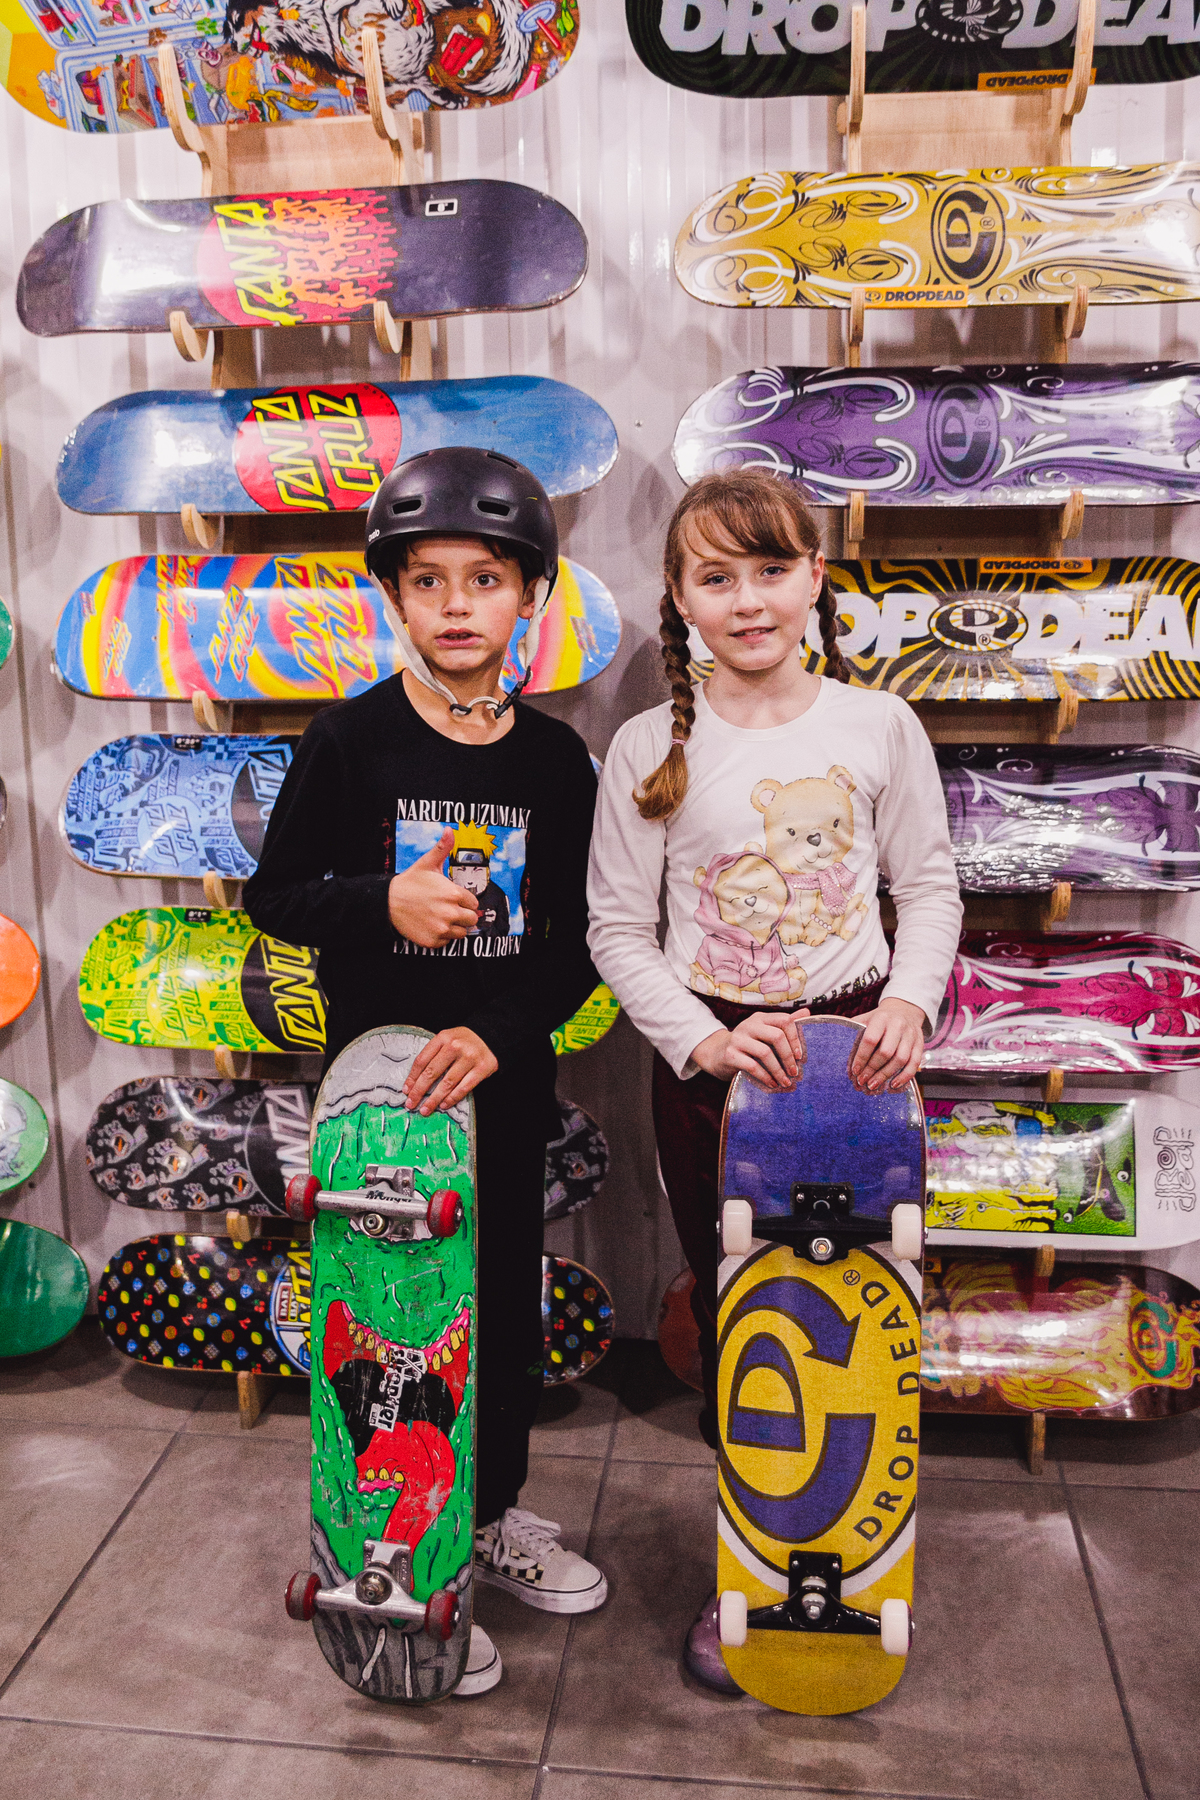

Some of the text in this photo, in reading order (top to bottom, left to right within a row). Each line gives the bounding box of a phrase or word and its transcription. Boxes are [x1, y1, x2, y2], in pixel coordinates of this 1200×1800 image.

[1001, 0, 1200, 48] DEA
[985, 73, 1069, 87] DROPDEAD
[884, 290, 965, 302] DROPDEAD
[252, 394, 330, 512] SANTA
[308, 393, 382, 493] CRUZ
[983, 560, 1061, 570] DROPDEAD
[209, 583, 245, 684] SANTA
[229, 598, 260, 683] CRUZ
[274, 557, 346, 698] SANTA
[316, 562, 379, 682] CRUZ
[1011, 594, 1200, 661] DEA
[144, 803, 180, 867] SANTA
[396, 798, 531, 829] NARUTO UZUMAKI
[473, 935, 524, 957] NARUTO
[157, 974, 188, 1041] SANTA
[258, 934, 328, 1053] SANT
[281, 1289, 289, 1317] BAR
[852, 1281, 920, 1542] DROP DEAD
